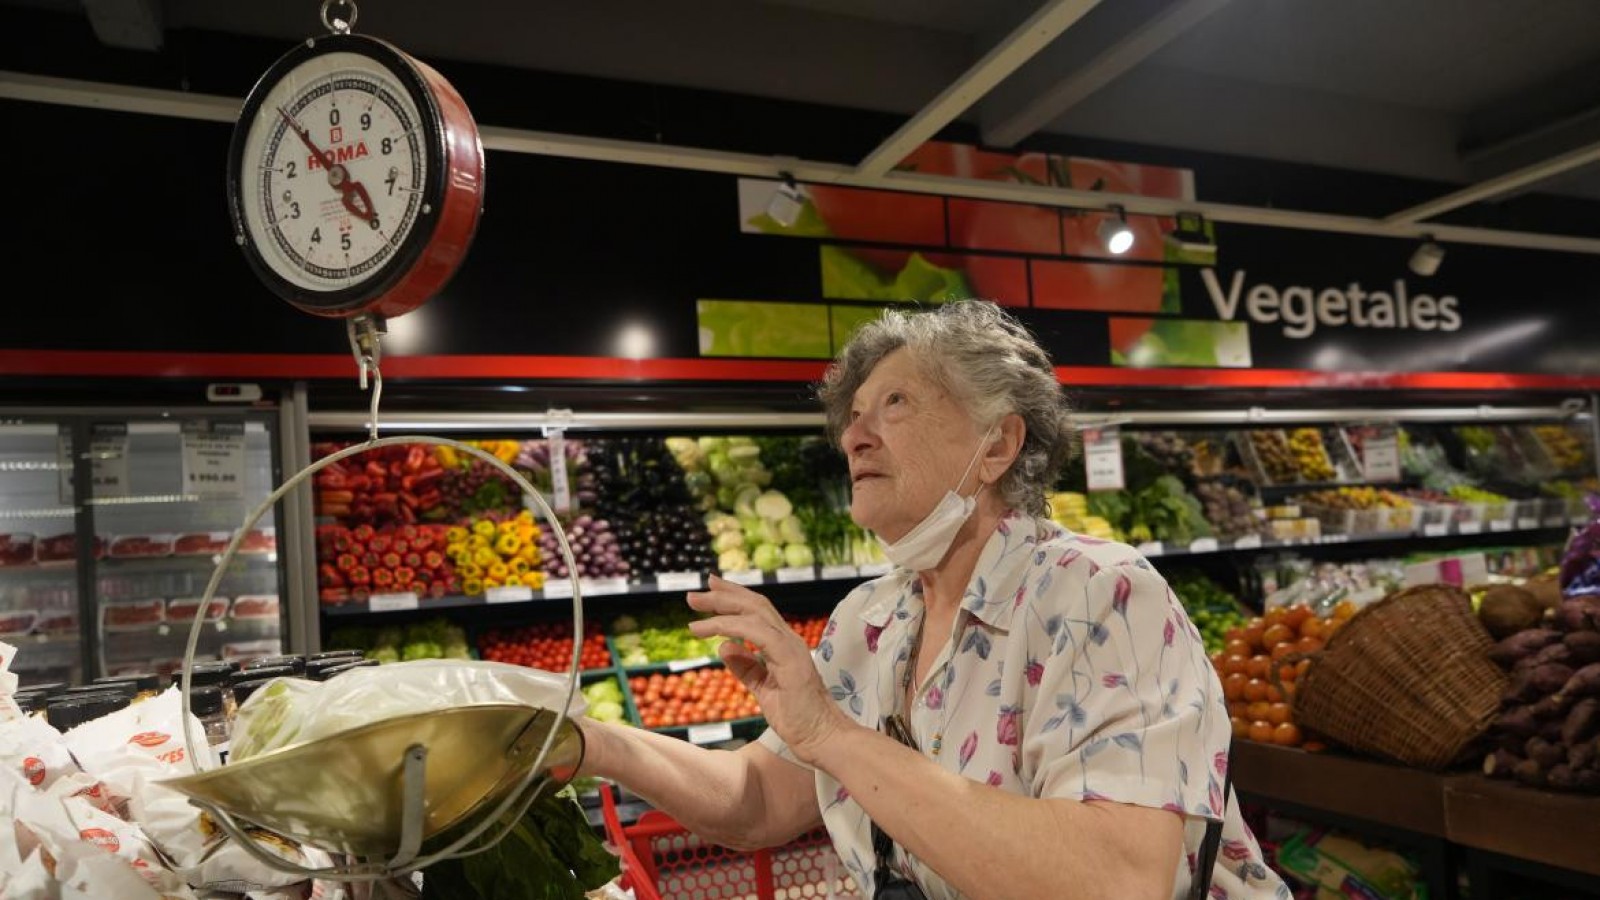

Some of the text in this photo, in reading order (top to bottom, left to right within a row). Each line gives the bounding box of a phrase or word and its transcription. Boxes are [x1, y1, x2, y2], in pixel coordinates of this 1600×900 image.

[329, 108, 340, 126] 0
[360, 113, 371, 130] 9
[382, 138, 392, 155] 8
[308, 142, 368, 170] ROMA
[286, 161, 297, 179] 2
[384, 178, 395, 196] 7
[290, 201, 301, 219] 3
[310, 227, 321, 243] 4
[341, 233, 351, 251] 5
[1201, 268, 1462, 339] Vegetales
